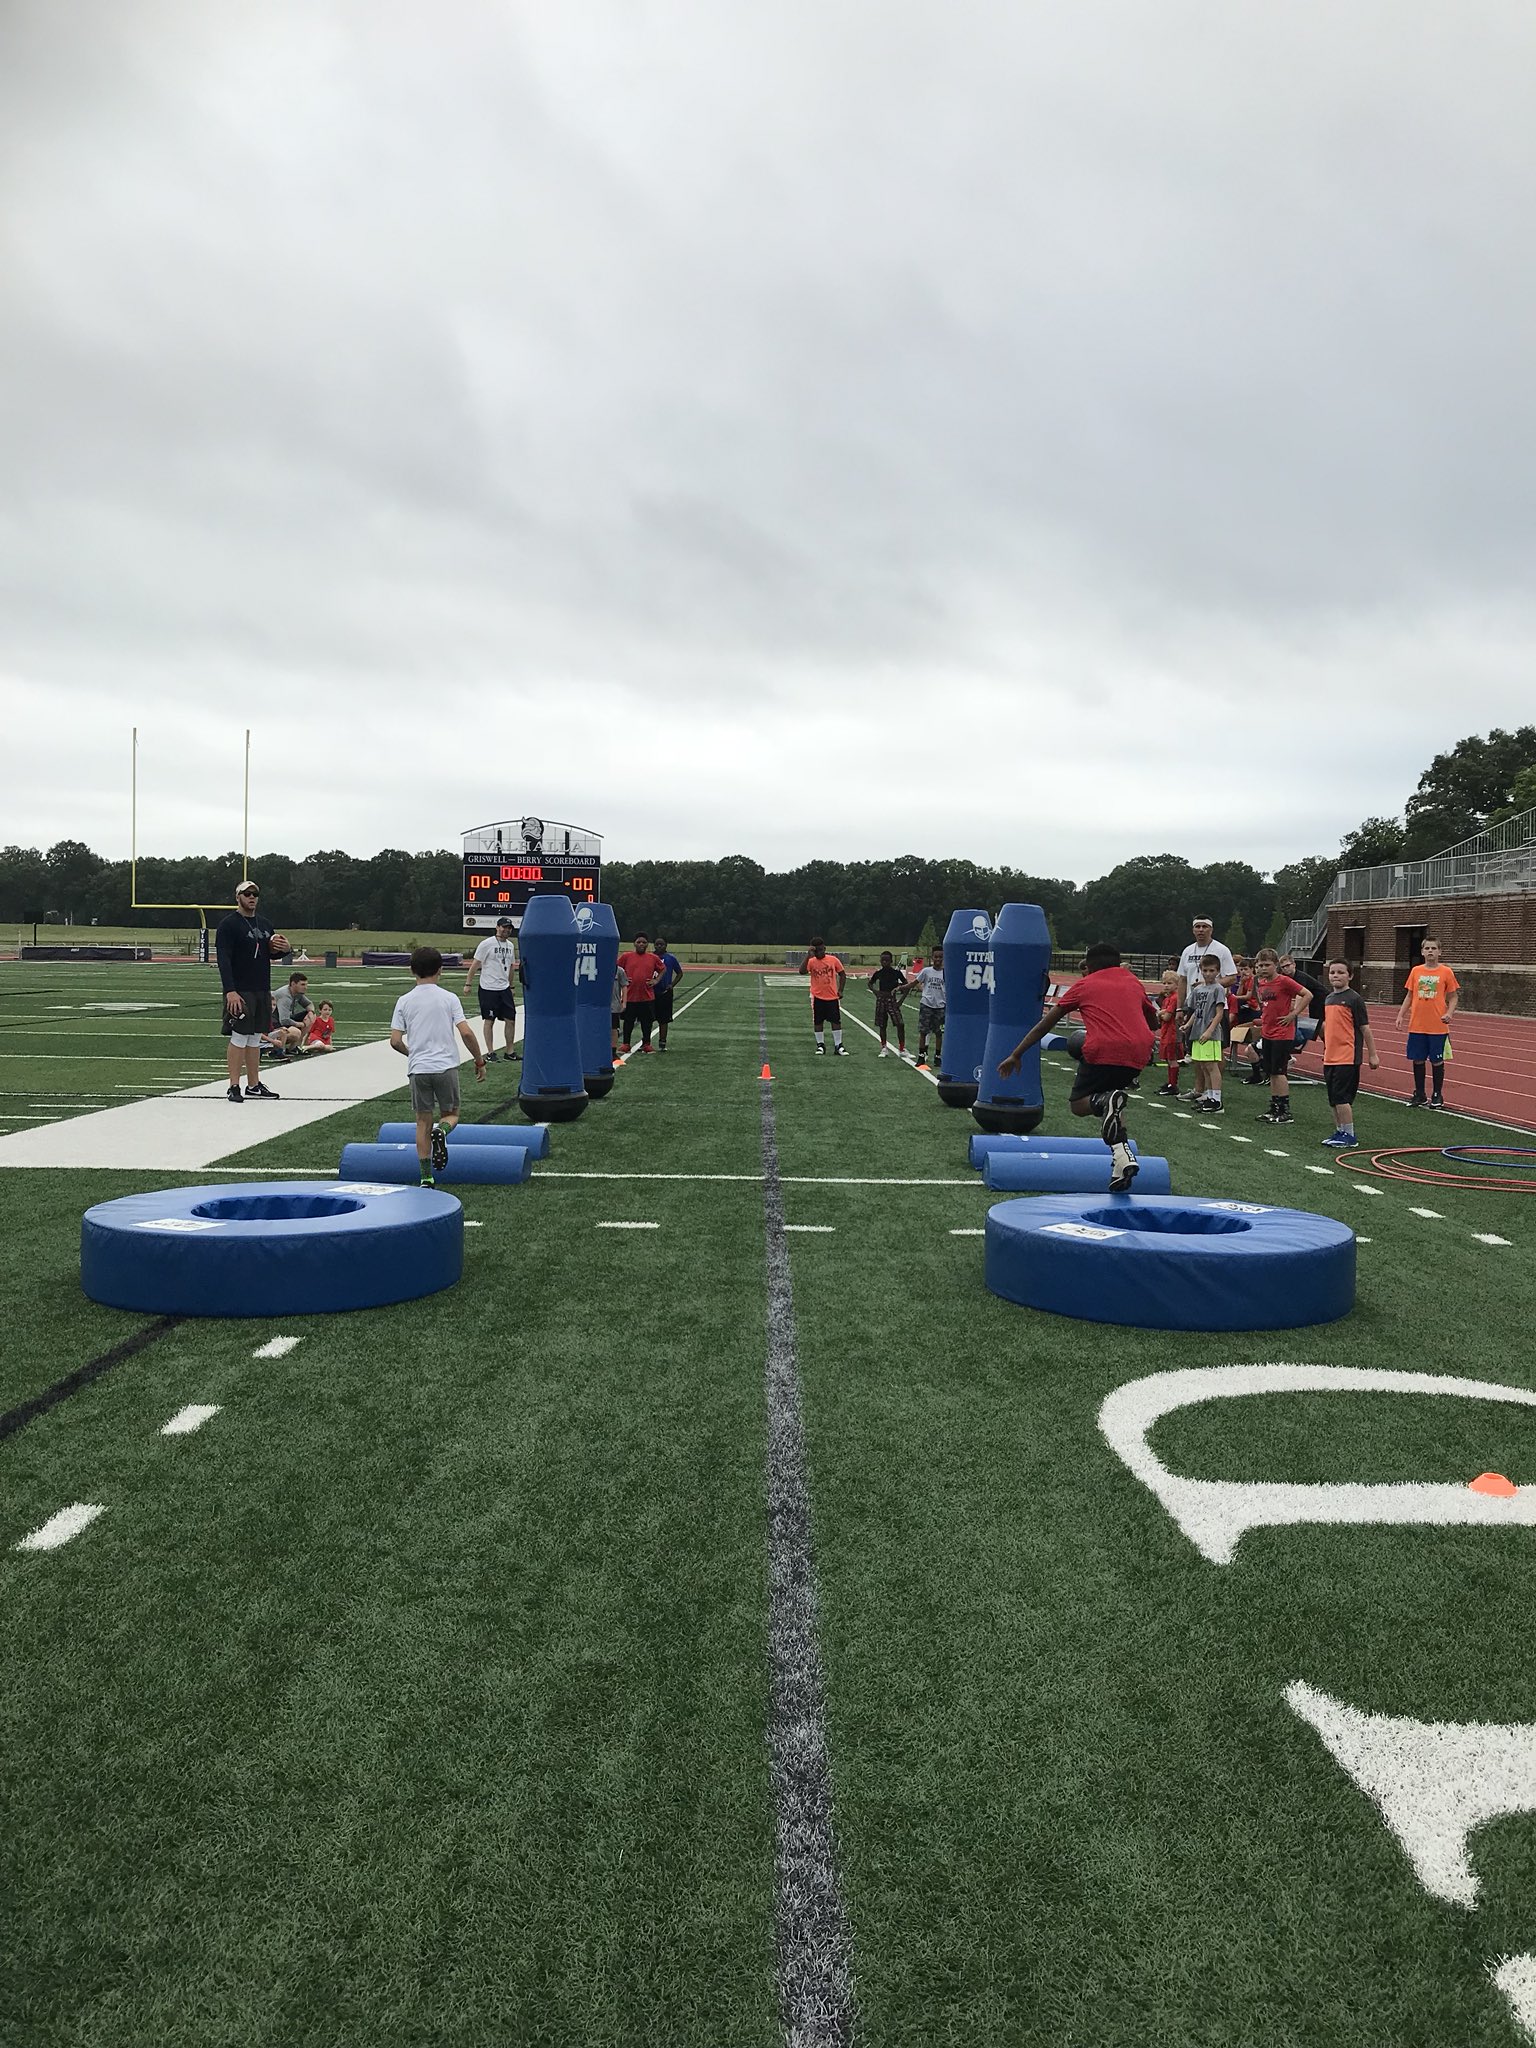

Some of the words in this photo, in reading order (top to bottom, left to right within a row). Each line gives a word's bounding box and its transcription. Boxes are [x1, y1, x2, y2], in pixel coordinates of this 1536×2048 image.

[481, 840, 584, 853] VALHALLA
[545, 857, 596, 866] SCOREBOARD
[471, 875, 490, 889] 00
[573, 878, 593, 891] 00
[469, 892, 475, 901] 0
[498, 892, 510, 902] 00
[966, 951, 995, 963] TITAN
[965, 964, 996, 993] 64
